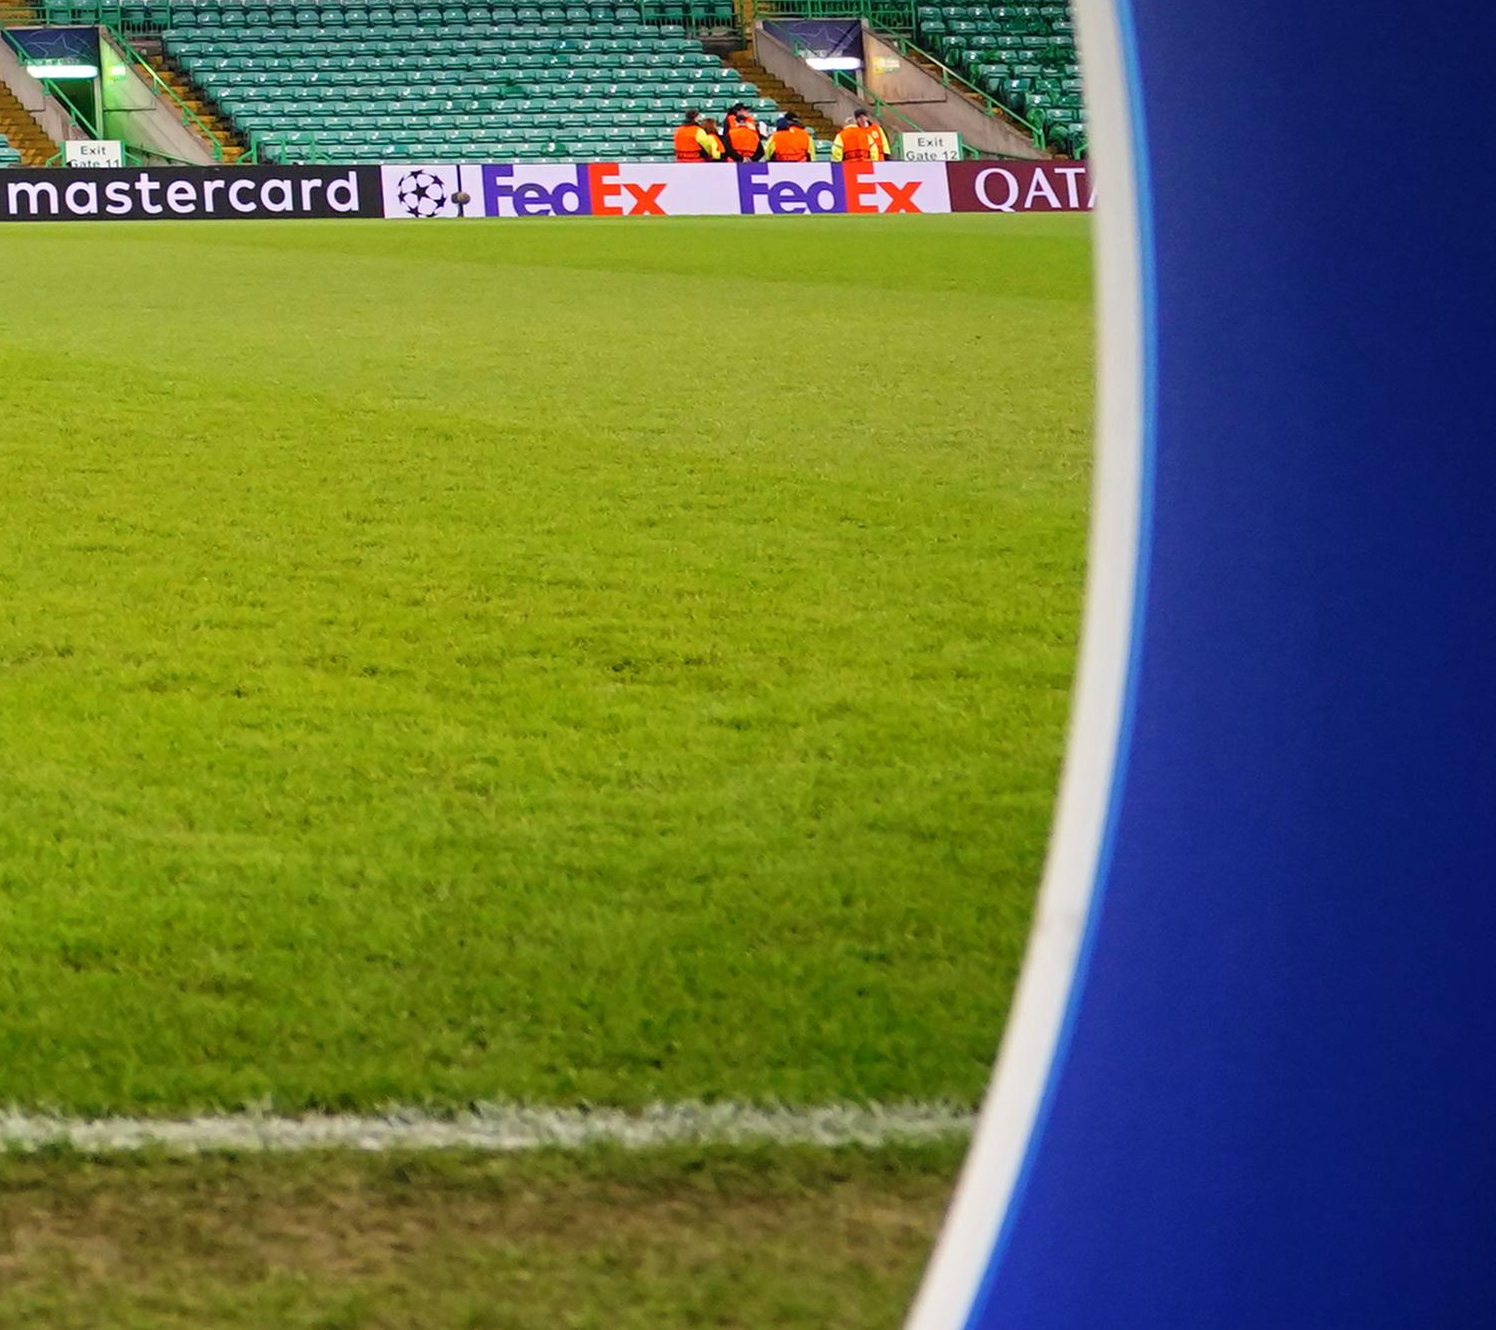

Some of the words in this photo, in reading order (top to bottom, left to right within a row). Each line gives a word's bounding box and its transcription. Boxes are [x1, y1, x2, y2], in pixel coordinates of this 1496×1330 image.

[80, 146, 107, 155] Exit
[905, 151, 938, 161] Gate
[942, 151, 958, 161] 12
[917, 138, 944, 147] Exit
[70, 160, 101, 169] Gate
[106, 160, 120, 169] 11
[7, 171, 360, 215] mastercard
[483, 162, 668, 217] FedEx
[738, 161, 923, 216] FedEx
[974, 167, 1097, 213] QAT
